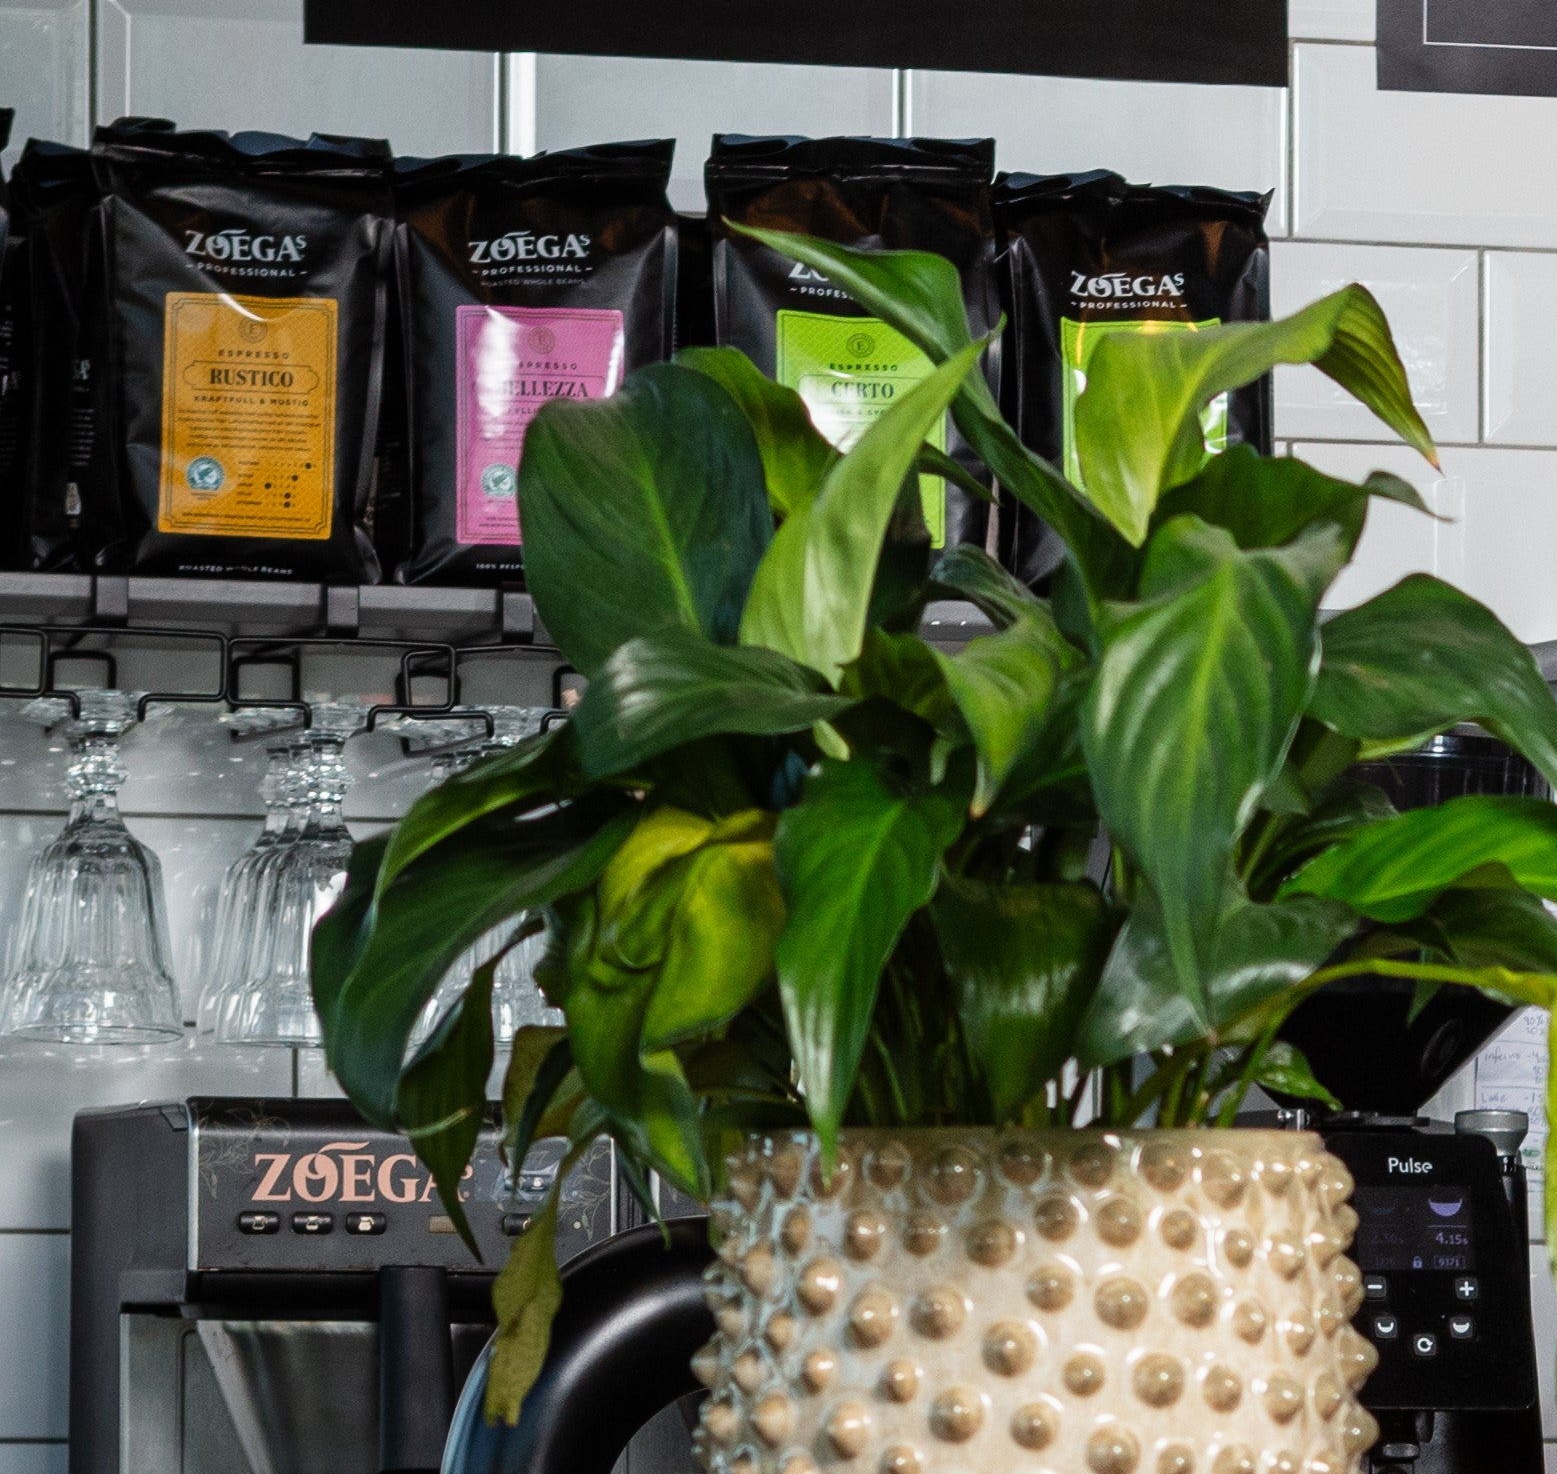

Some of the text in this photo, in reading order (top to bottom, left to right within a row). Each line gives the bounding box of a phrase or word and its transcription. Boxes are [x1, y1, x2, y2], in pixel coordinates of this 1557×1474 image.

[197, 262, 295, 277] PROFESSIONAL
[482, 265, 582, 276] PROFESSIONAL
[1082, 299, 1177, 311] PROFESSIONAL
[218, 349, 290, 360] ESPRESSO
[829, 363, 899, 372] ESPRESSO
[210, 368, 295, 388] RUSTICO
[1388, 1157, 1433, 1173] Pulse
